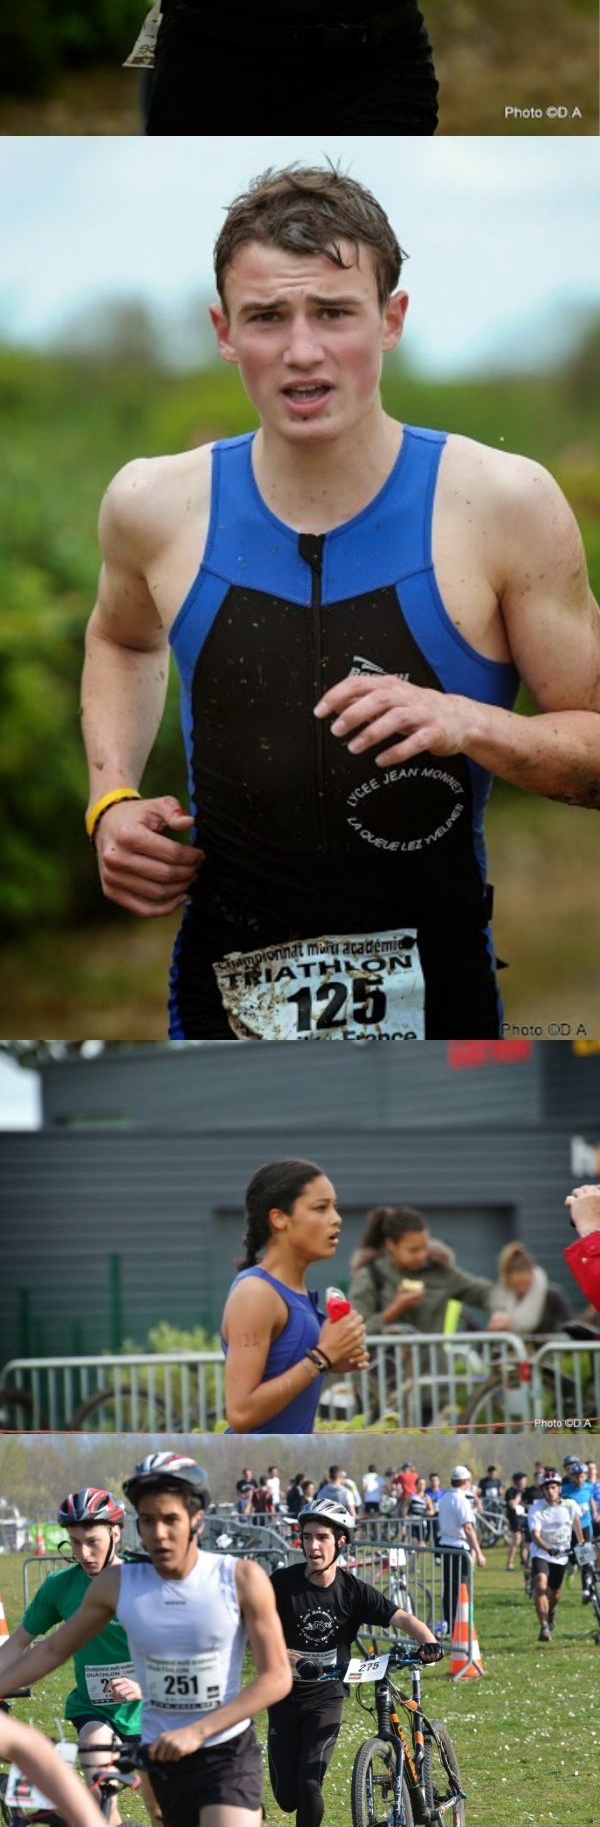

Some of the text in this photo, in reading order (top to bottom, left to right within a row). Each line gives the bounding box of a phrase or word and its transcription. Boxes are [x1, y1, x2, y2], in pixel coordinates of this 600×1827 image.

[346, 767, 464, 807] LYCEE JEAN MONNET
[346, 803, 464, 852] LA QUEUE LEZ YVELINES
[224, 954, 413, 988] TRIATHLON
[287, 977, 387, 1033] 125
[164, 1675, 199, 1695] 251
[358, 1661, 380, 1672] 275
